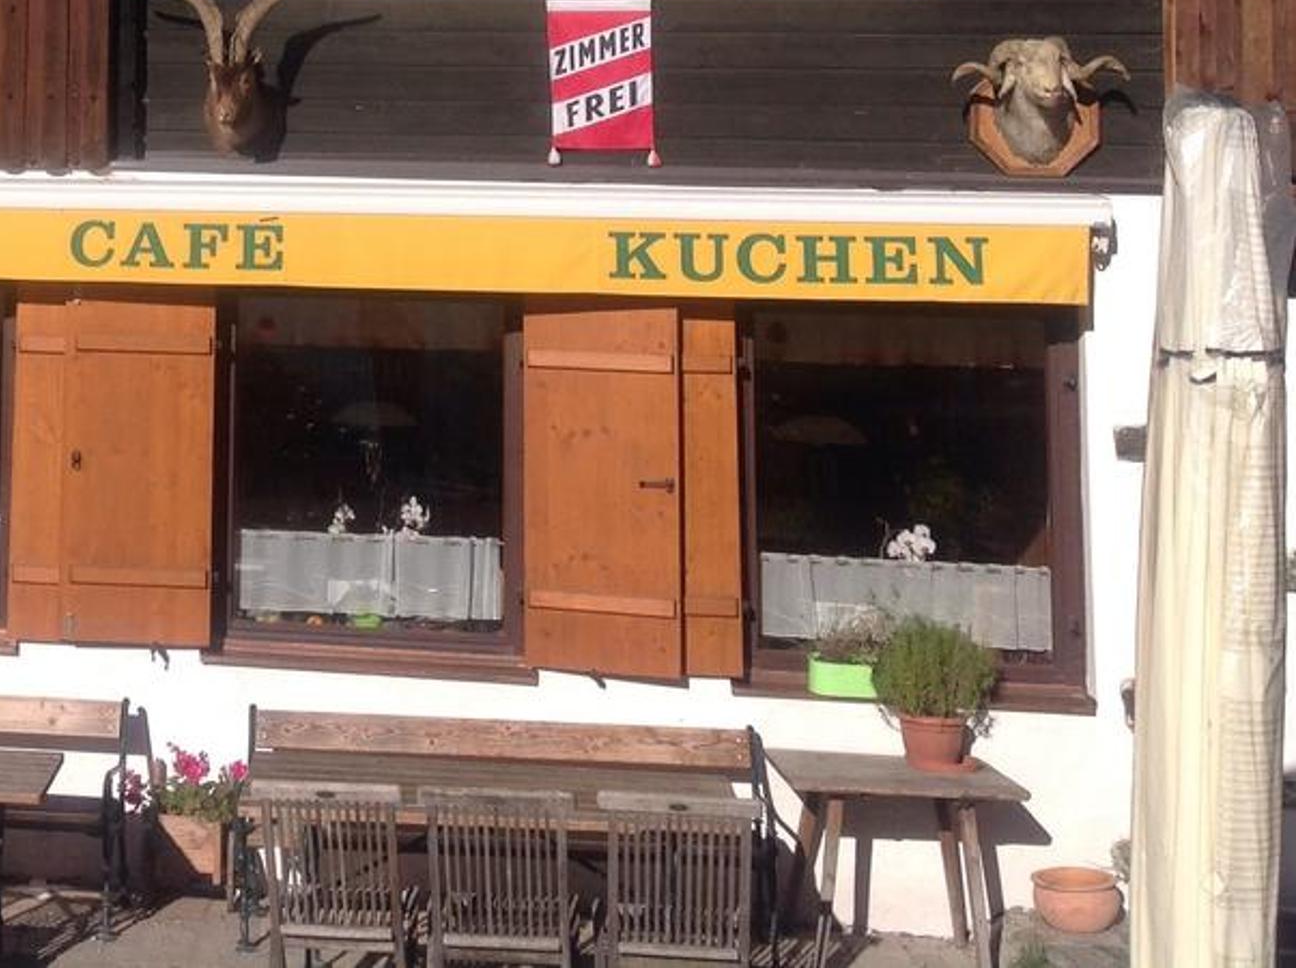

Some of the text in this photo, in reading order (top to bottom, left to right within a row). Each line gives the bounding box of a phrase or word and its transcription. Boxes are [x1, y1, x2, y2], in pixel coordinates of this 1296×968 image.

[554, 22, 646, 76] ZIMMER
[565, 81, 640, 128] FREI
[69, 216, 285, 272] CAFÉ
[607, 231, 990, 286] KUCHEN
